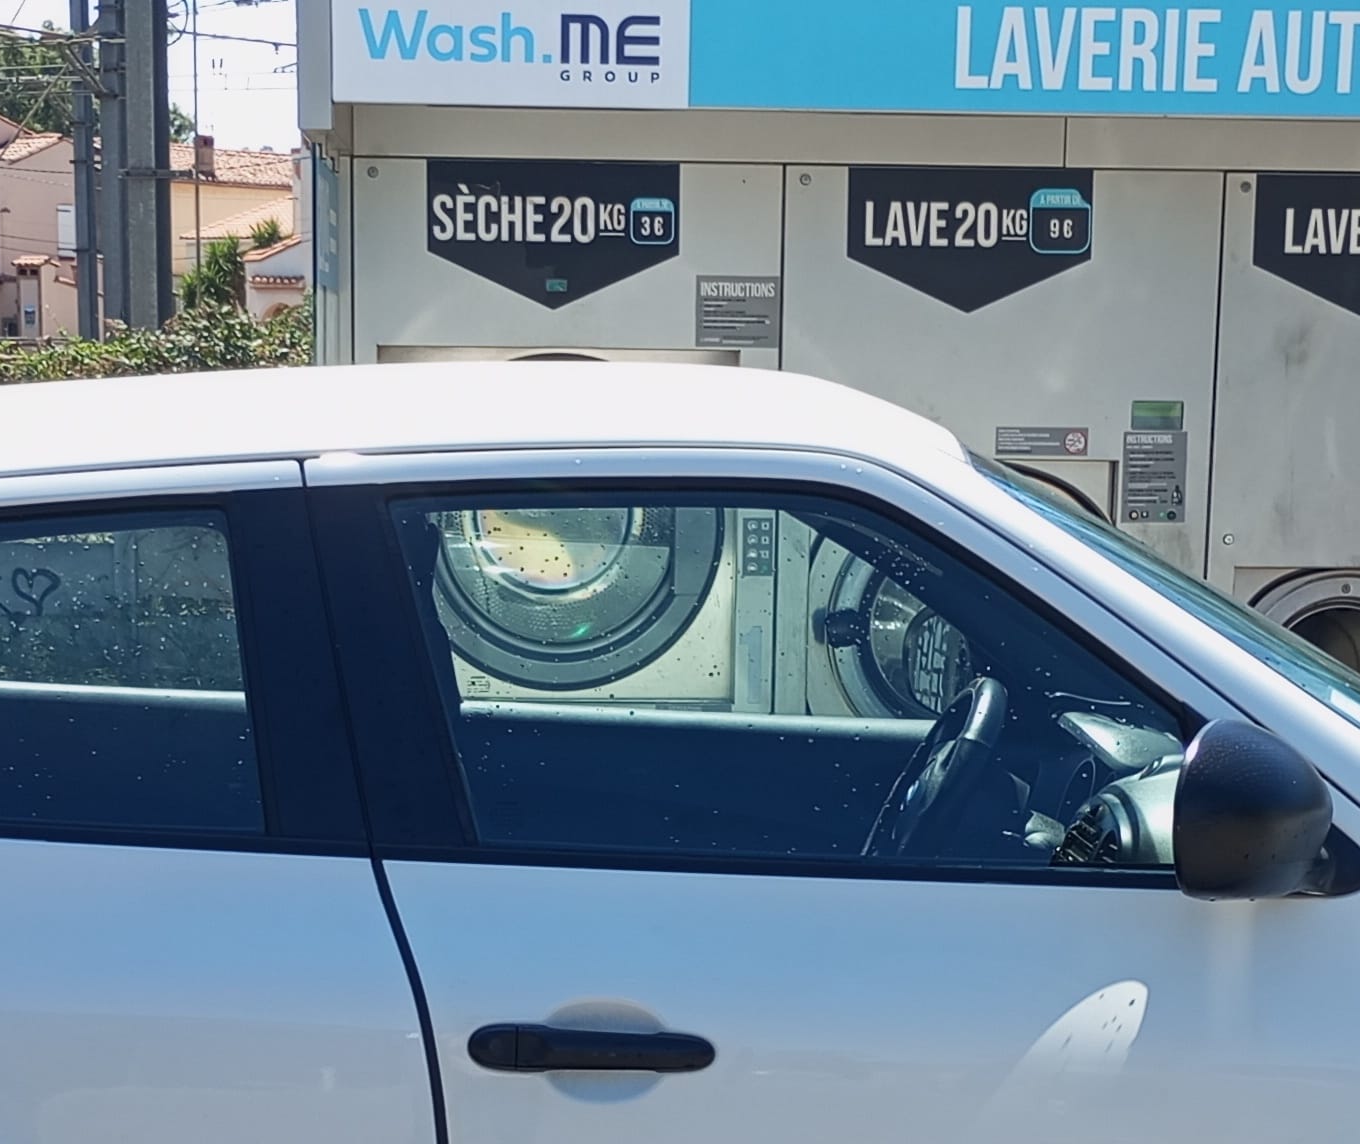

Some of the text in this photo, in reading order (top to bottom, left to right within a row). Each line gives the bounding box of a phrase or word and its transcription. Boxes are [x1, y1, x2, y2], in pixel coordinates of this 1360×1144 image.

[358, 8, 661, 66] Wash.ME
[955, 6, 1220, 93] LAVERIE
[560, 70, 660, 84] GROUP
[432, 183, 626, 244] SÈCHE 20 KG
[865, 201, 1028, 248] LAVE 20 KG
[700, 281, 776, 297] INSTRUCTIONS
